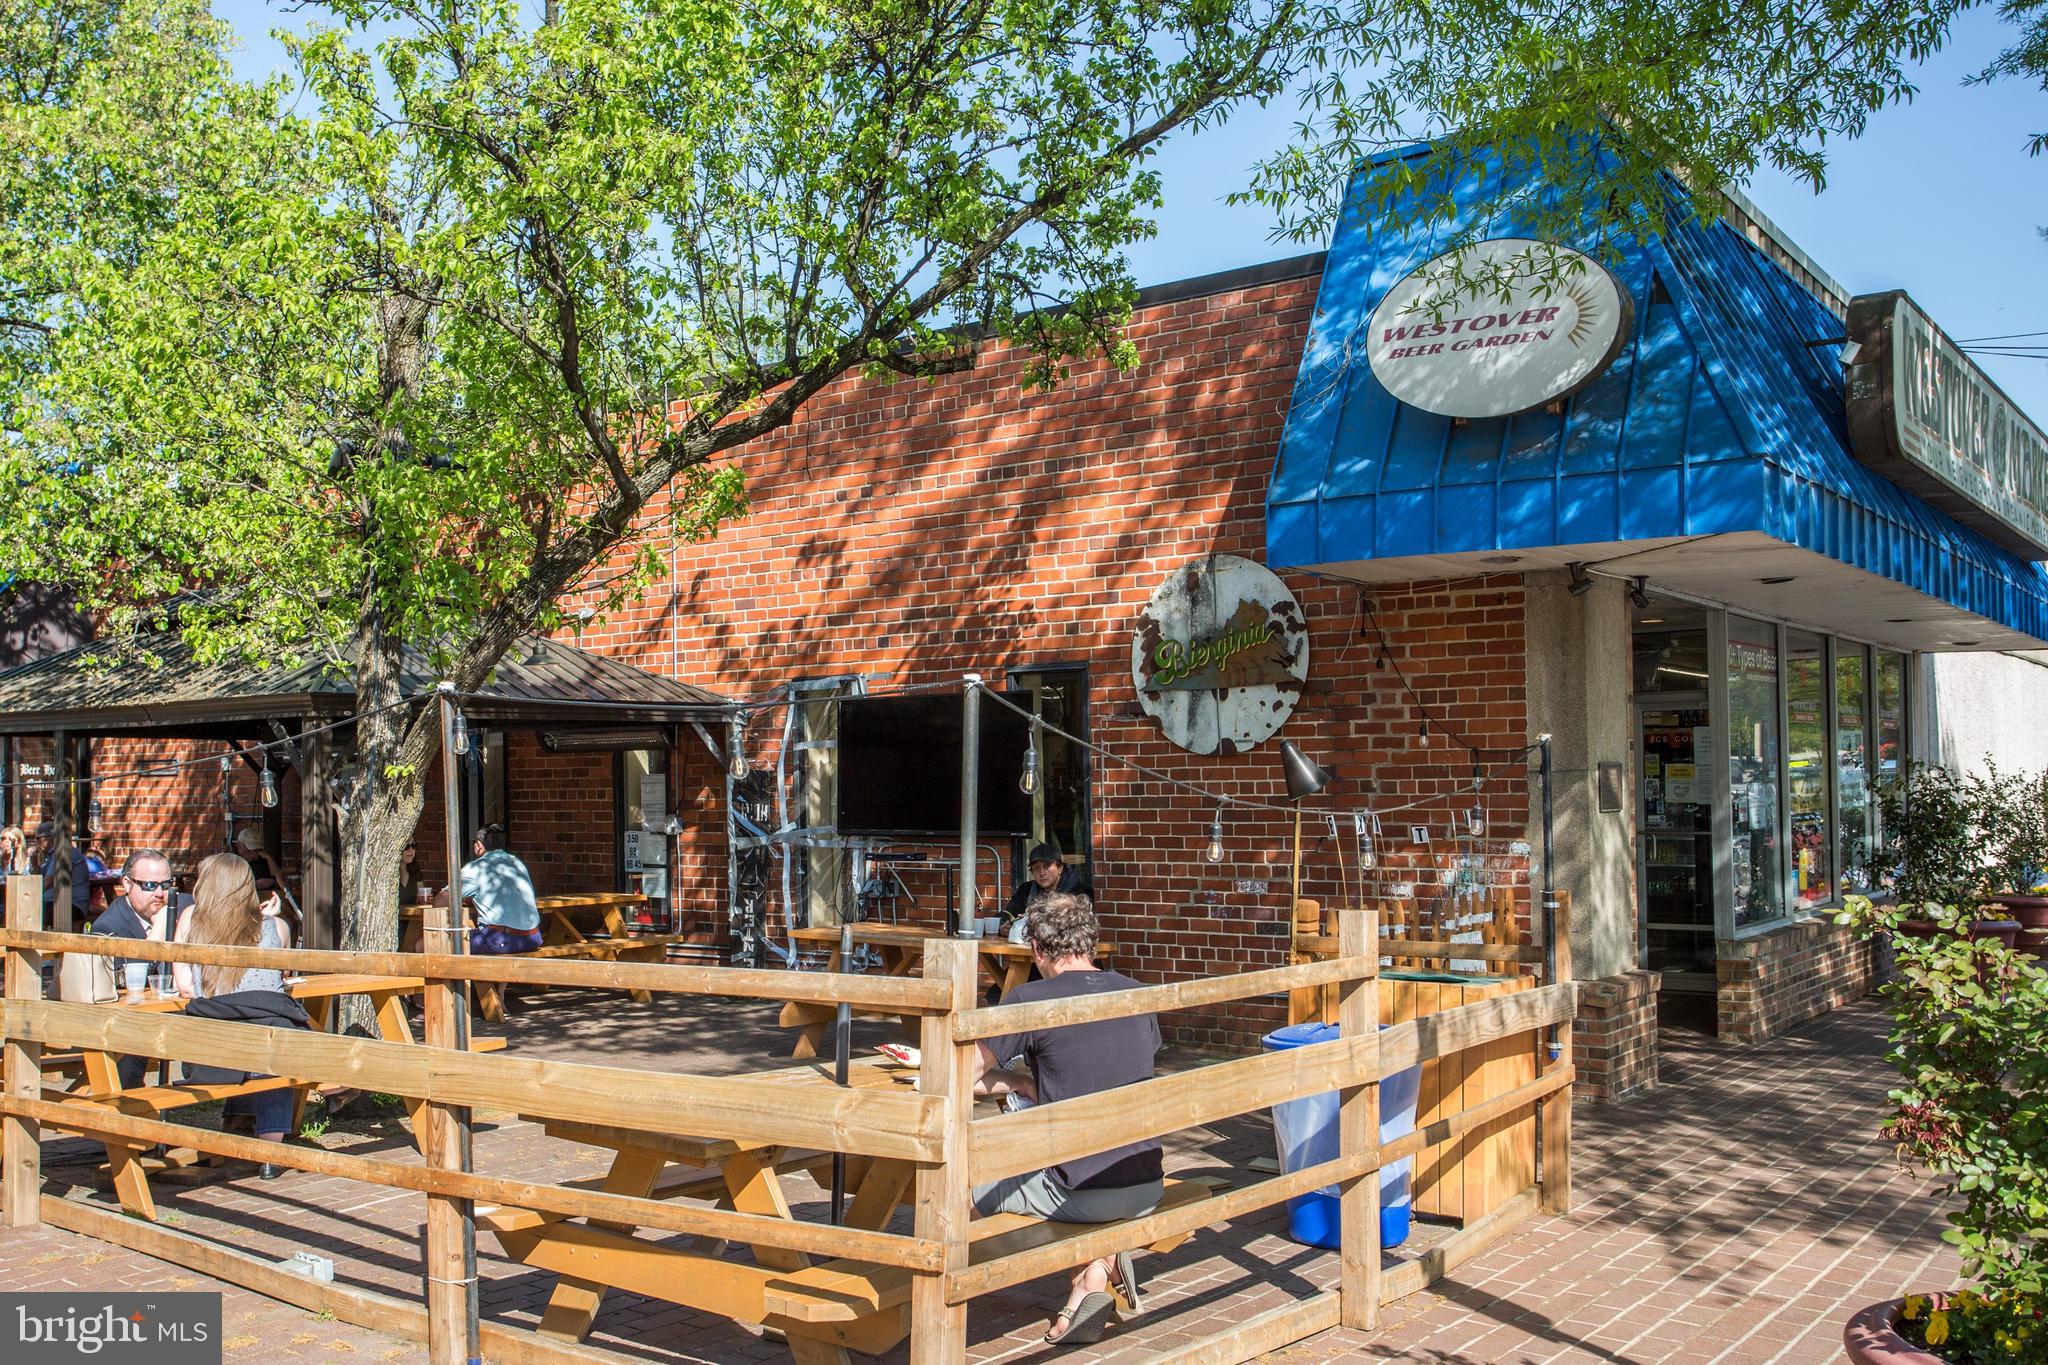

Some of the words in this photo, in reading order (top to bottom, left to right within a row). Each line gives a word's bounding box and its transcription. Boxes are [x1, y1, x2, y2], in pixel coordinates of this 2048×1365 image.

[1383, 306, 1561, 343] WESTOVER
[1389, 343, 1445, 360] BEER
[1451, 328, 1554, 352] GARDEN
[1903, 313, 1990, 473] WESTOVER
[1154, 620, 1276, 685] Bierginia
[1736, 645, 1755, 671] Types
[1755, 649, 1763, 668] of
[1650, 734, 1669, 744] ICE
[20, 763, 41, 777] Beer
[1415, 828, 1424, 842] T
